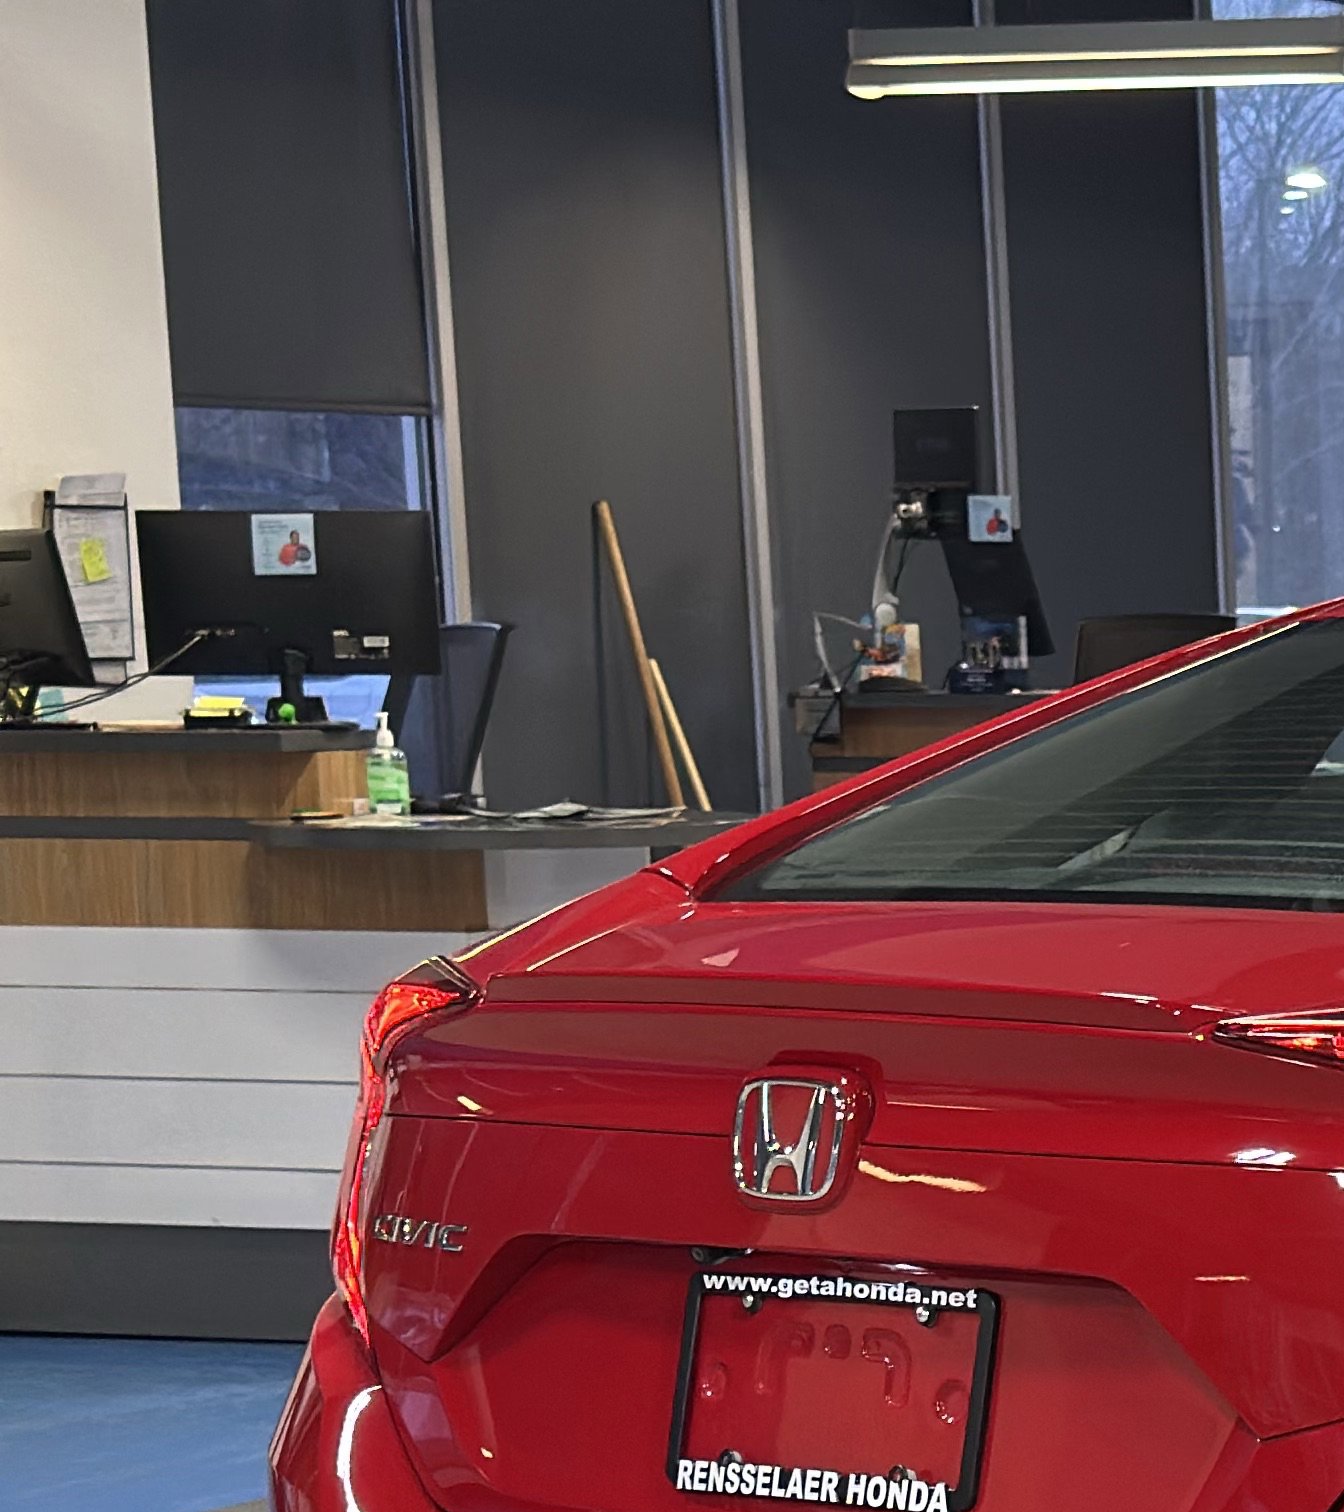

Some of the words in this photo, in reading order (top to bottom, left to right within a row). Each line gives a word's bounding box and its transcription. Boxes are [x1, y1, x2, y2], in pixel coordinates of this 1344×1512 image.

[373, 1214, 468, 1252] CIVIC
[702, 1273, 978, 1308] www.getahonda.net
[675, 1459, 839, 1503] RENSSELAER
